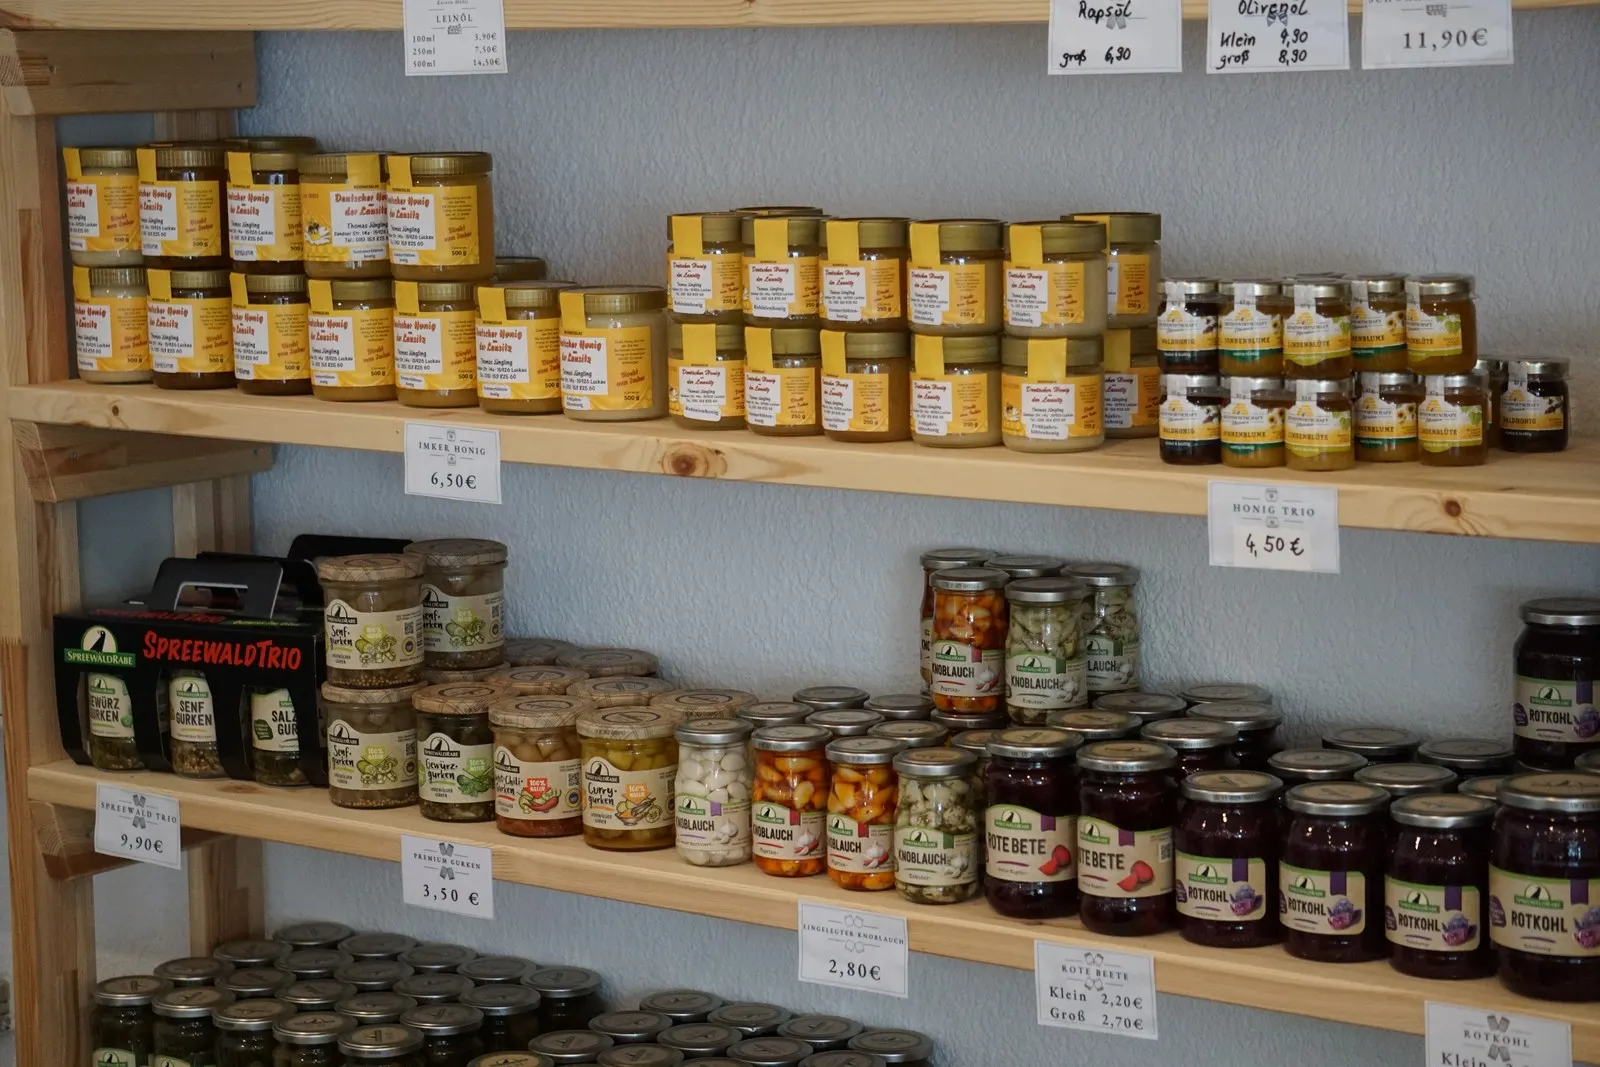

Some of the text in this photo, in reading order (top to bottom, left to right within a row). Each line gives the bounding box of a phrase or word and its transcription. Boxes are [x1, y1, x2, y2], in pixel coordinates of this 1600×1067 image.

[436, 13, 472, 23] LEINÖL
[412, 32, 496, 42] 100ml 3,90€
[1280, 28, 1308, 48] 4,90
[1404, 28, 1488, 51] 11,90€
[412, 47, 436, 55] 250ml
[1060, 46, 1131, 68] groß 6,90
[1216, 49, 1307, 70] groß 8,90
[413, 60, 436, 68] 500ml
[419, 442, 486, 456] IMKER HONIG
[431, 472, 476, 489] 6,50€
[1233, 504, 1315, 517] HONIG TRIO
[1011, 675, 1059, 689] KNOBLAUCH
[180, 700, 204, 713] SENF
[176, 713, 212, 726] GURKEN
[1530, 709, 1572, 724] ROTKOHL
[101, 802, 177, 823] SPREEWALD TRIO
[121, 834, 163, 853] 9,90€
[988, 832, 1046, 854] ROTE BETE
[414, 853, 480, 869] PREMIUM GURKEN
[899, 850, 946, 865] KNOBLAUCH
[1093, 850, 1124, 870] BETE
[1188, 886, 1229, 902] ROTKOHL
[1288, 897, 1326, 916] ROTKOHL
[1398, 913, 1440, 932] ROTKOHL
[1512, 910, 1568, 933] ROTKOHL
[804, 924, 904, 944] EINGELEGTER KNOBLAUCH
[829, 959, 880, 981] 2,80€
[1062, 964, 1128, 981] ROTE BEETE
[1050, 986, 1142, 1009] Klein 2,20€
[1050, 1007, 1143, 1030] Groß 2,70€
[1464, 1030, 1530, 1048] ROTKOHL
[1442, 1052, 1486, 1067] Klein
